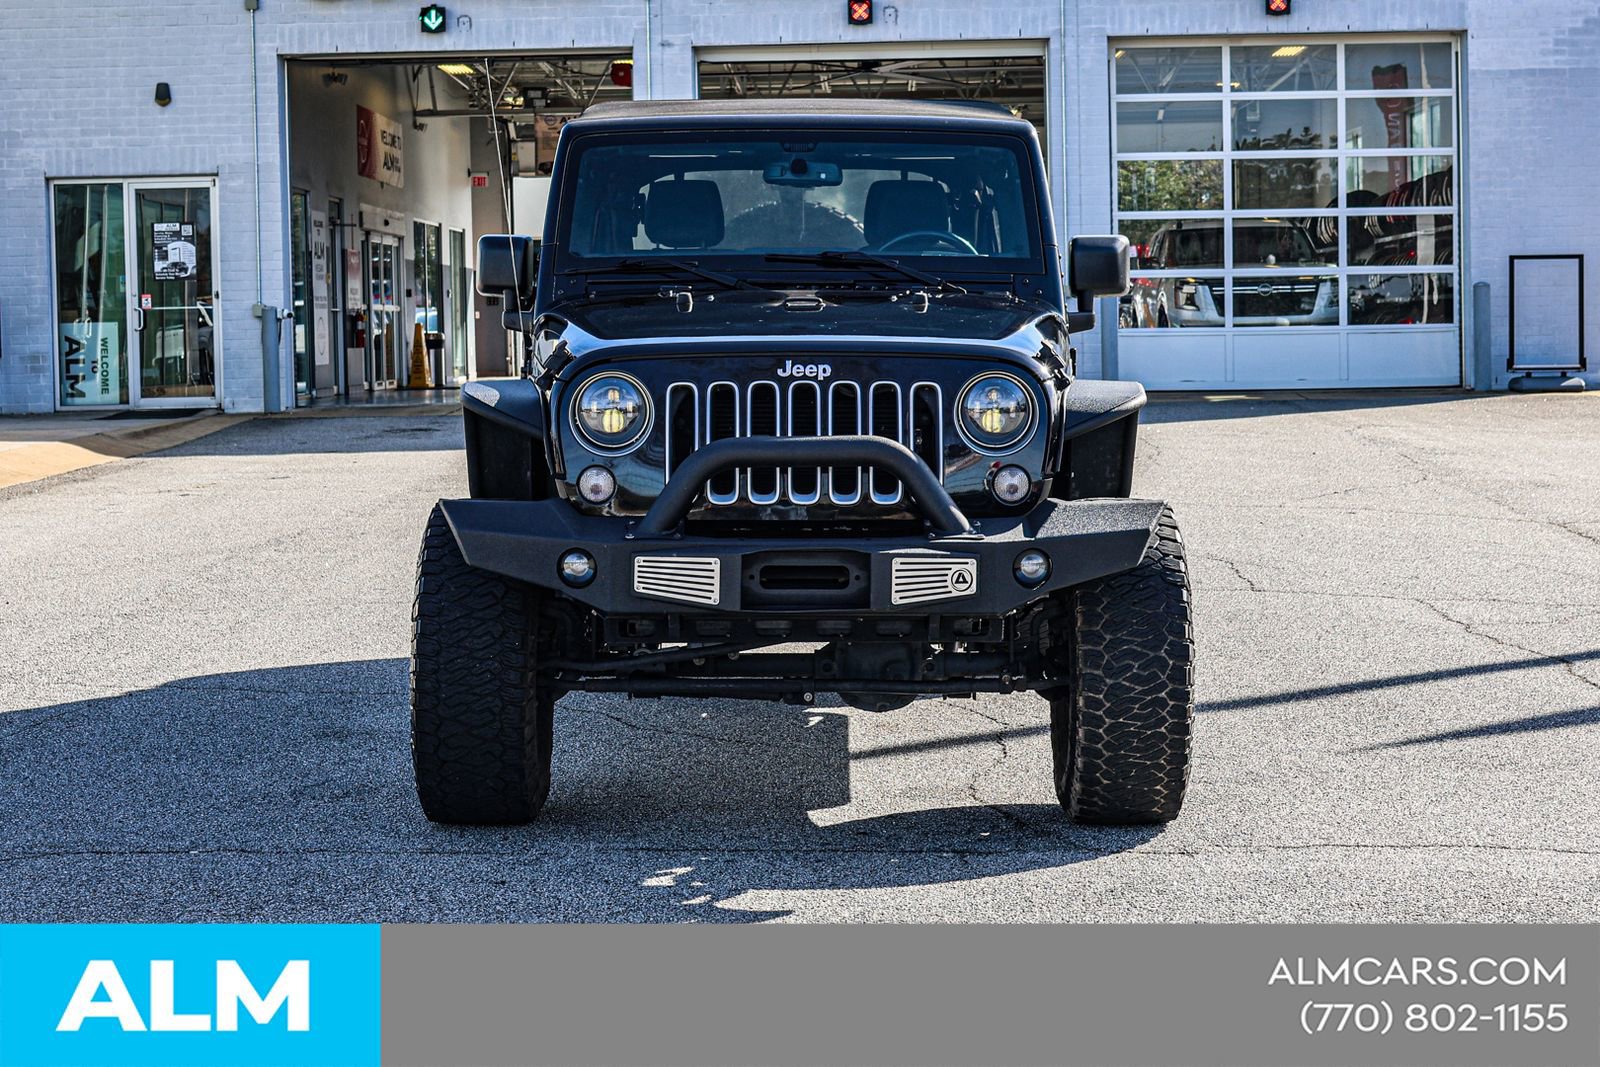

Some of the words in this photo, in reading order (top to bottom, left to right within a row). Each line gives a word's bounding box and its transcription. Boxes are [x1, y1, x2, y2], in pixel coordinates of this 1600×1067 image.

[473, 176, 486, 187] EXIT
[64, 336, 86, 398] ALM
[91, 357, 99, 374] TO
[100, 337, 110, 395] WELCOME
[777, 360, 831, 380] Jeep
